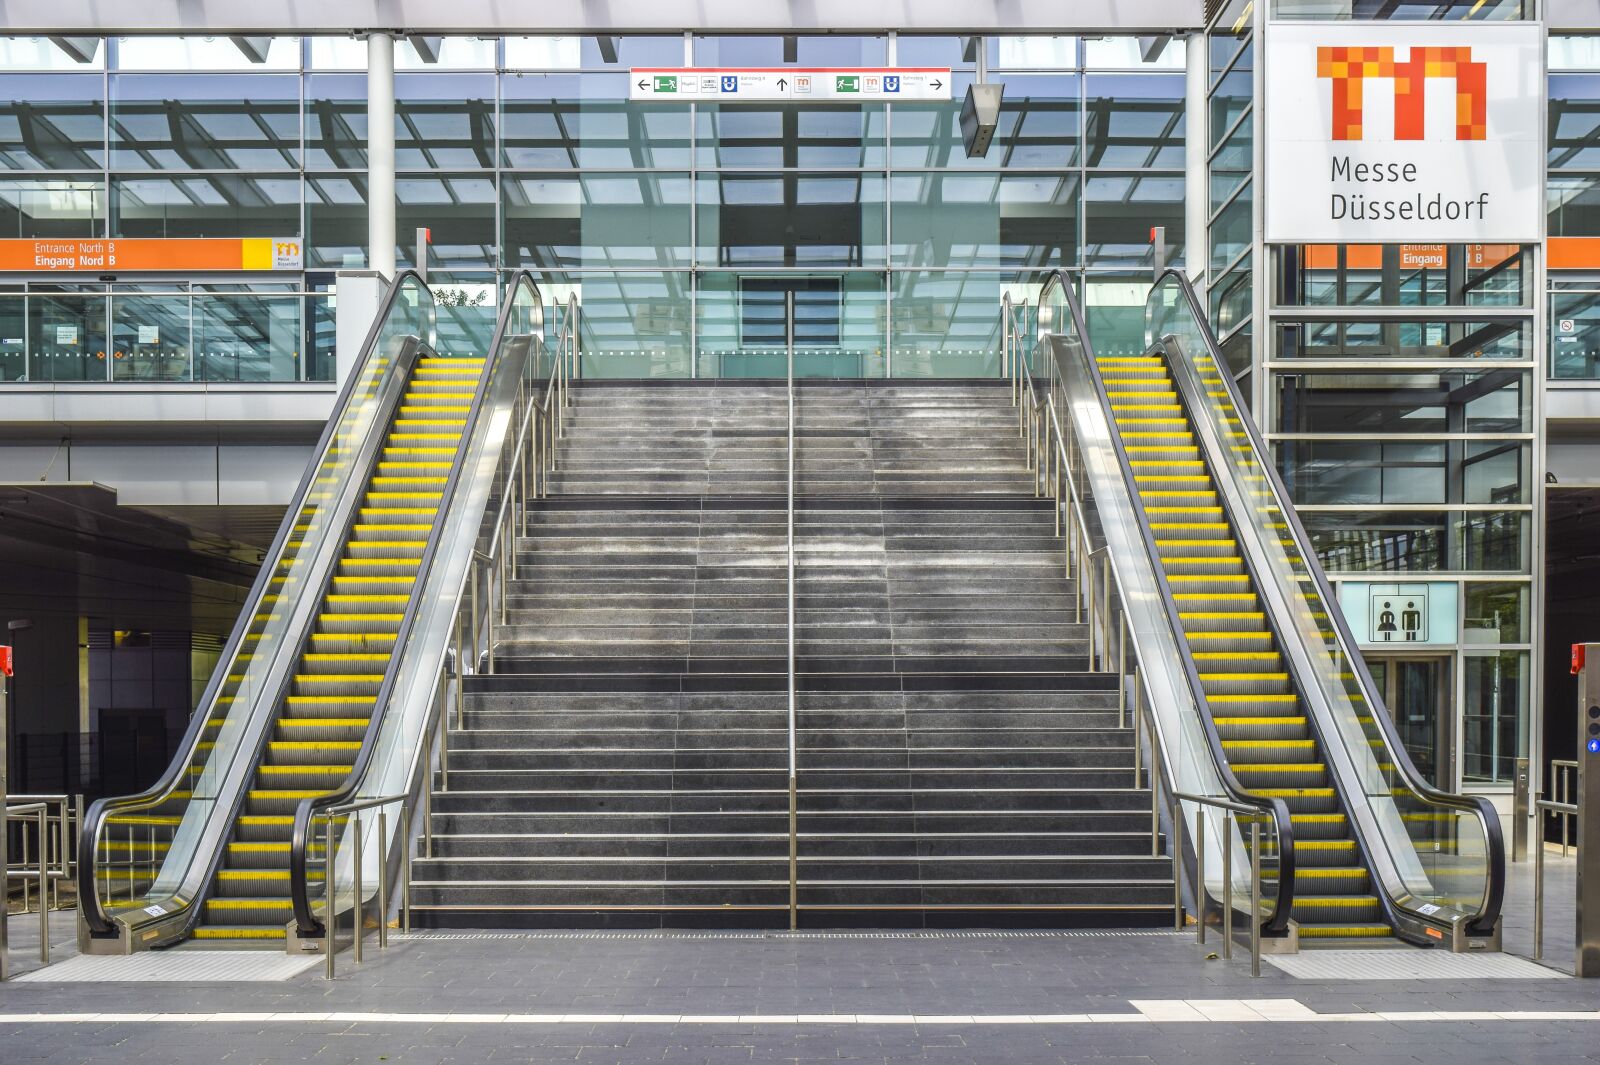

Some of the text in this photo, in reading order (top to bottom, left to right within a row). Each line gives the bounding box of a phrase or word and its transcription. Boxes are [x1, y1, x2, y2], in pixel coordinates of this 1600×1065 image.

[1331, 156, 1417, 182] Messe
[1331, 193, 1489, 220] Düsseldorf
[35, 242, 115, 253] Entrance North B
[35, 255, 116, 268] Eingang Nord B
[1403, 253, 1443, 266] Eingang
[1475, 253, 1482, 264] B
